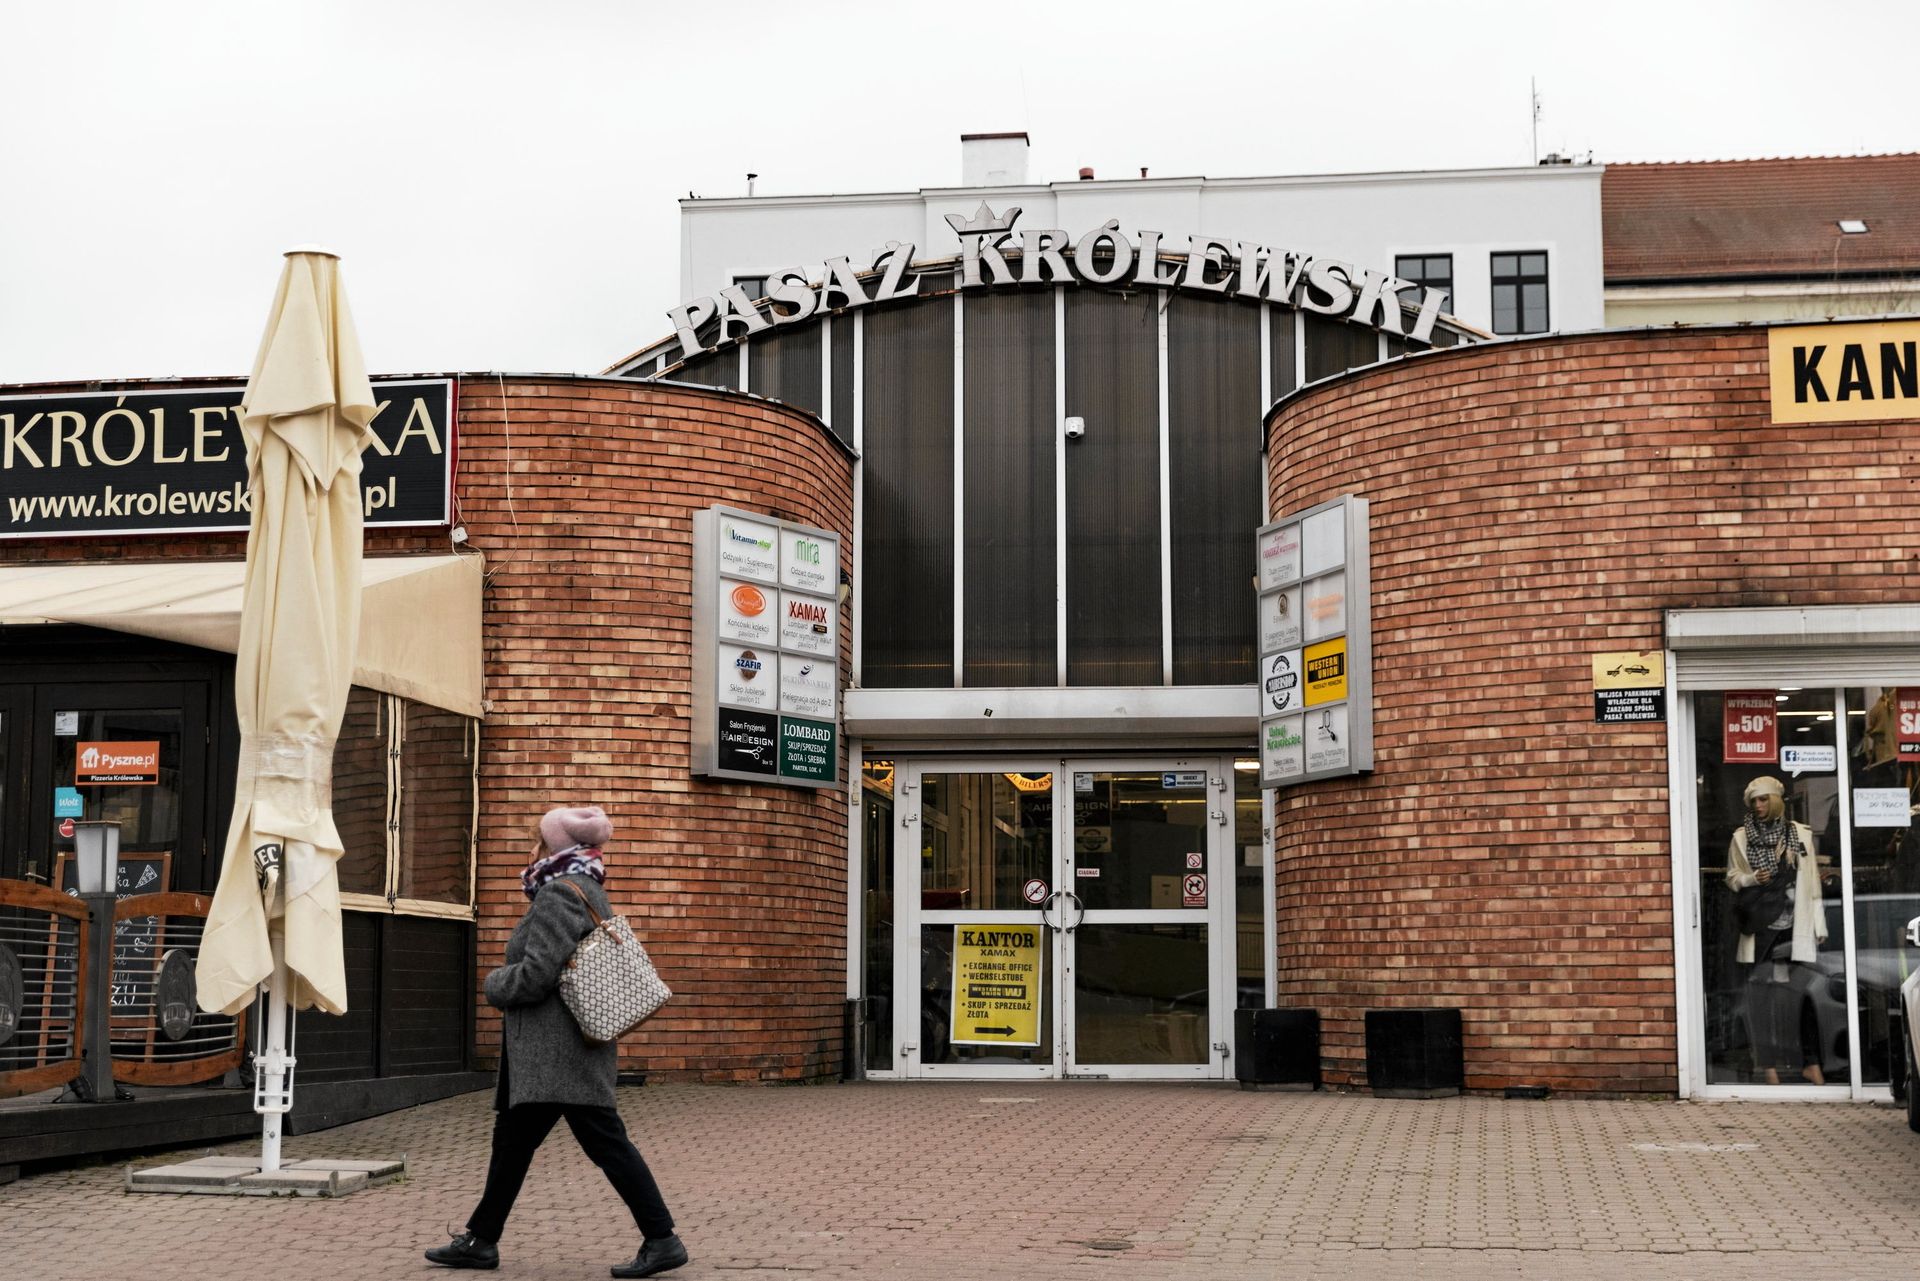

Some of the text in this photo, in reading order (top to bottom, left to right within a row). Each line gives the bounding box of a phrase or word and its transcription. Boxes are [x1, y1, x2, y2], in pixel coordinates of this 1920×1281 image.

[666, 218, 1450, 360] PASAŻ KRÓLEWSKI
[1793, 341, 1918, 403] KAN
[796, 538, 820, 565] mira
[790, 600, 827, 624] XAMAX
[736, 658, 762, 671] SZAFIR
[1308, 656, 1338, 672] WESTERN
[1318, 666, 1338, 680] UNION
[1598, 689, 1661, 698] MIEJSCA PARKINGOWE
[1728, 698, 1773, 709] WYPRZEDAŻ
[1624, 712, 1656, 720] KRÓLEWSKI
[730, 720, 744, 730] Salon
[1728, 714, 1773, 733] DO 50%
[784, 724, 831, 742] LOMBARD
[1735, 742, 1766, 753] TANIEJ
[102, 754, 155, 768] Pyszne.pl
[788, 752, 804, 762] ZŁOTA
[807, 755, 826, 766] SREBRA
[58, 798, 80, 807] Wolt
[962, 931, 1034, 948] KANTOR
[980, 948, 1016, 958] XAMAX
[968, 962, 1033, 972] EXCHANGE OFFICE
[968, 972, 1024, 982] WECHSELSTUBE
[968, 1001, 986, 1009] SKUP
[994, 1001, 1032, 1010] SPRZEDAŻ
[967, 1010, 989, 1018] ZŁOTA
